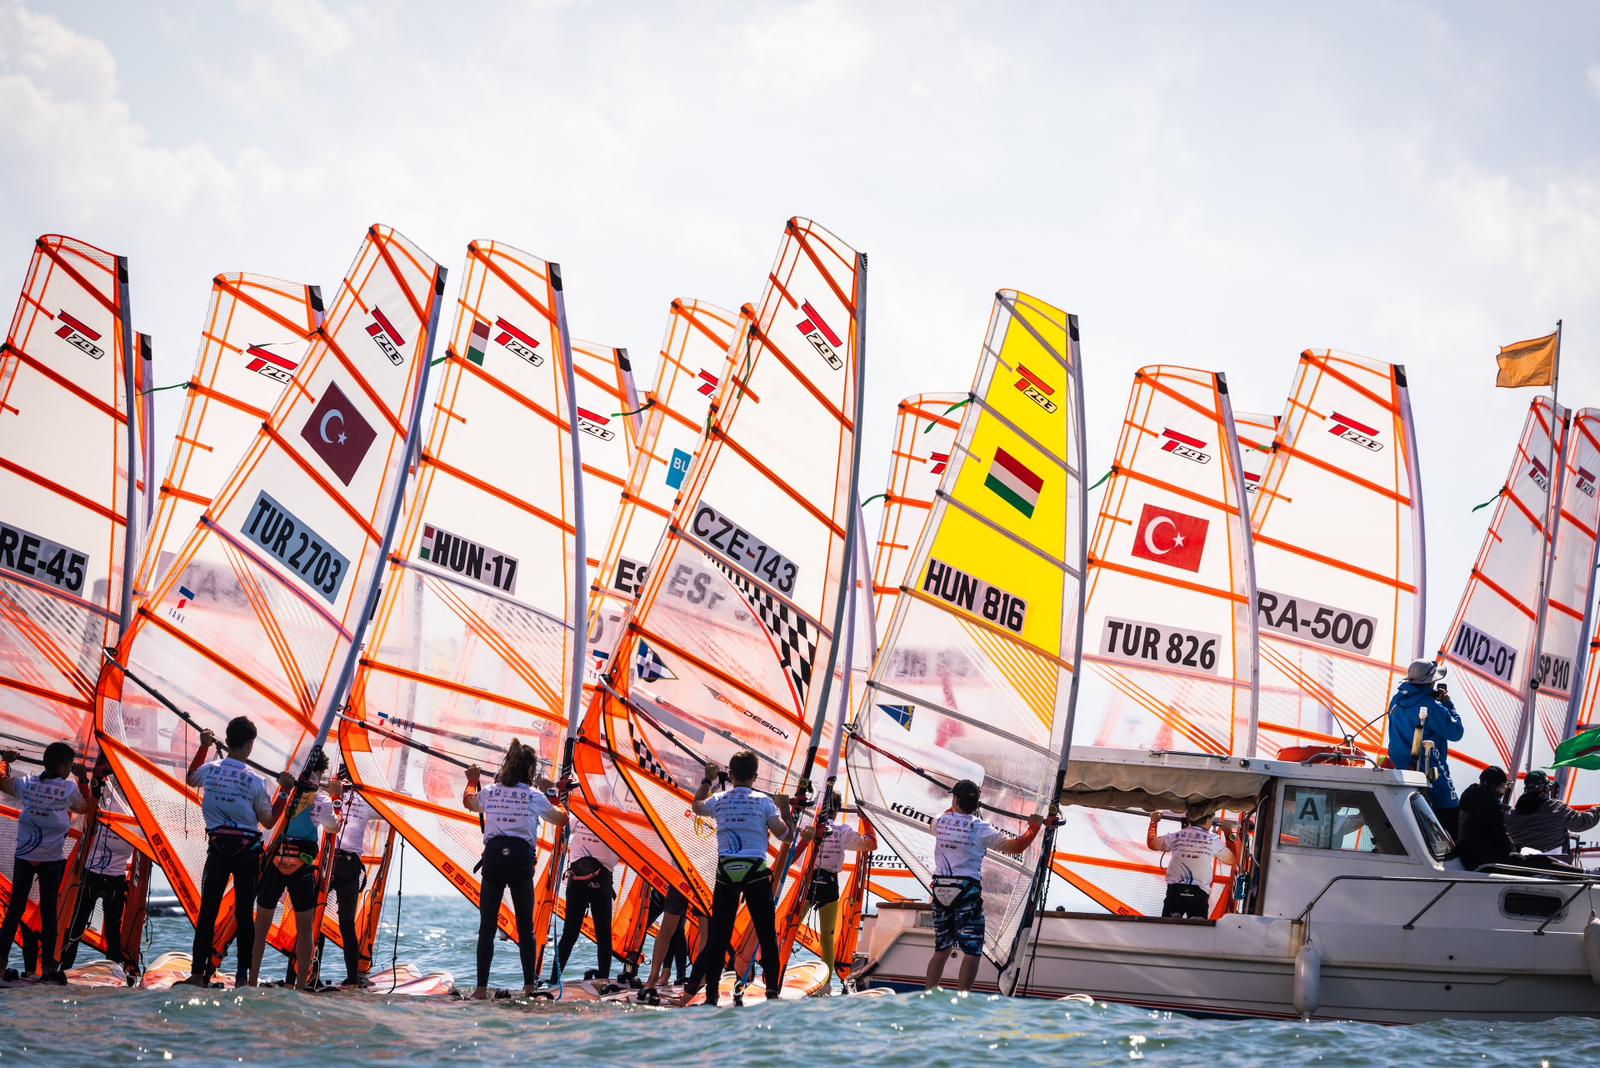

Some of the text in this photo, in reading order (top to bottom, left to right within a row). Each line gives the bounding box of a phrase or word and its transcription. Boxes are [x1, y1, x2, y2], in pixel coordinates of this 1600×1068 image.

[246, 500, 342, 593] TUR 2703
[432, 530, 516, 592] HUN-17
[692, 506, 796, 592] CZE-143
[923, 558, 1025, 631] HUN 816
[1257, 590, 1373, 650] RA-500
[1107, 621, 1215, 670] TUR 826
[1453, 624, 1516, 682] IND-01
[1552, 659, 1570, 690] 910
[1299, 797, 1320, 821] A
